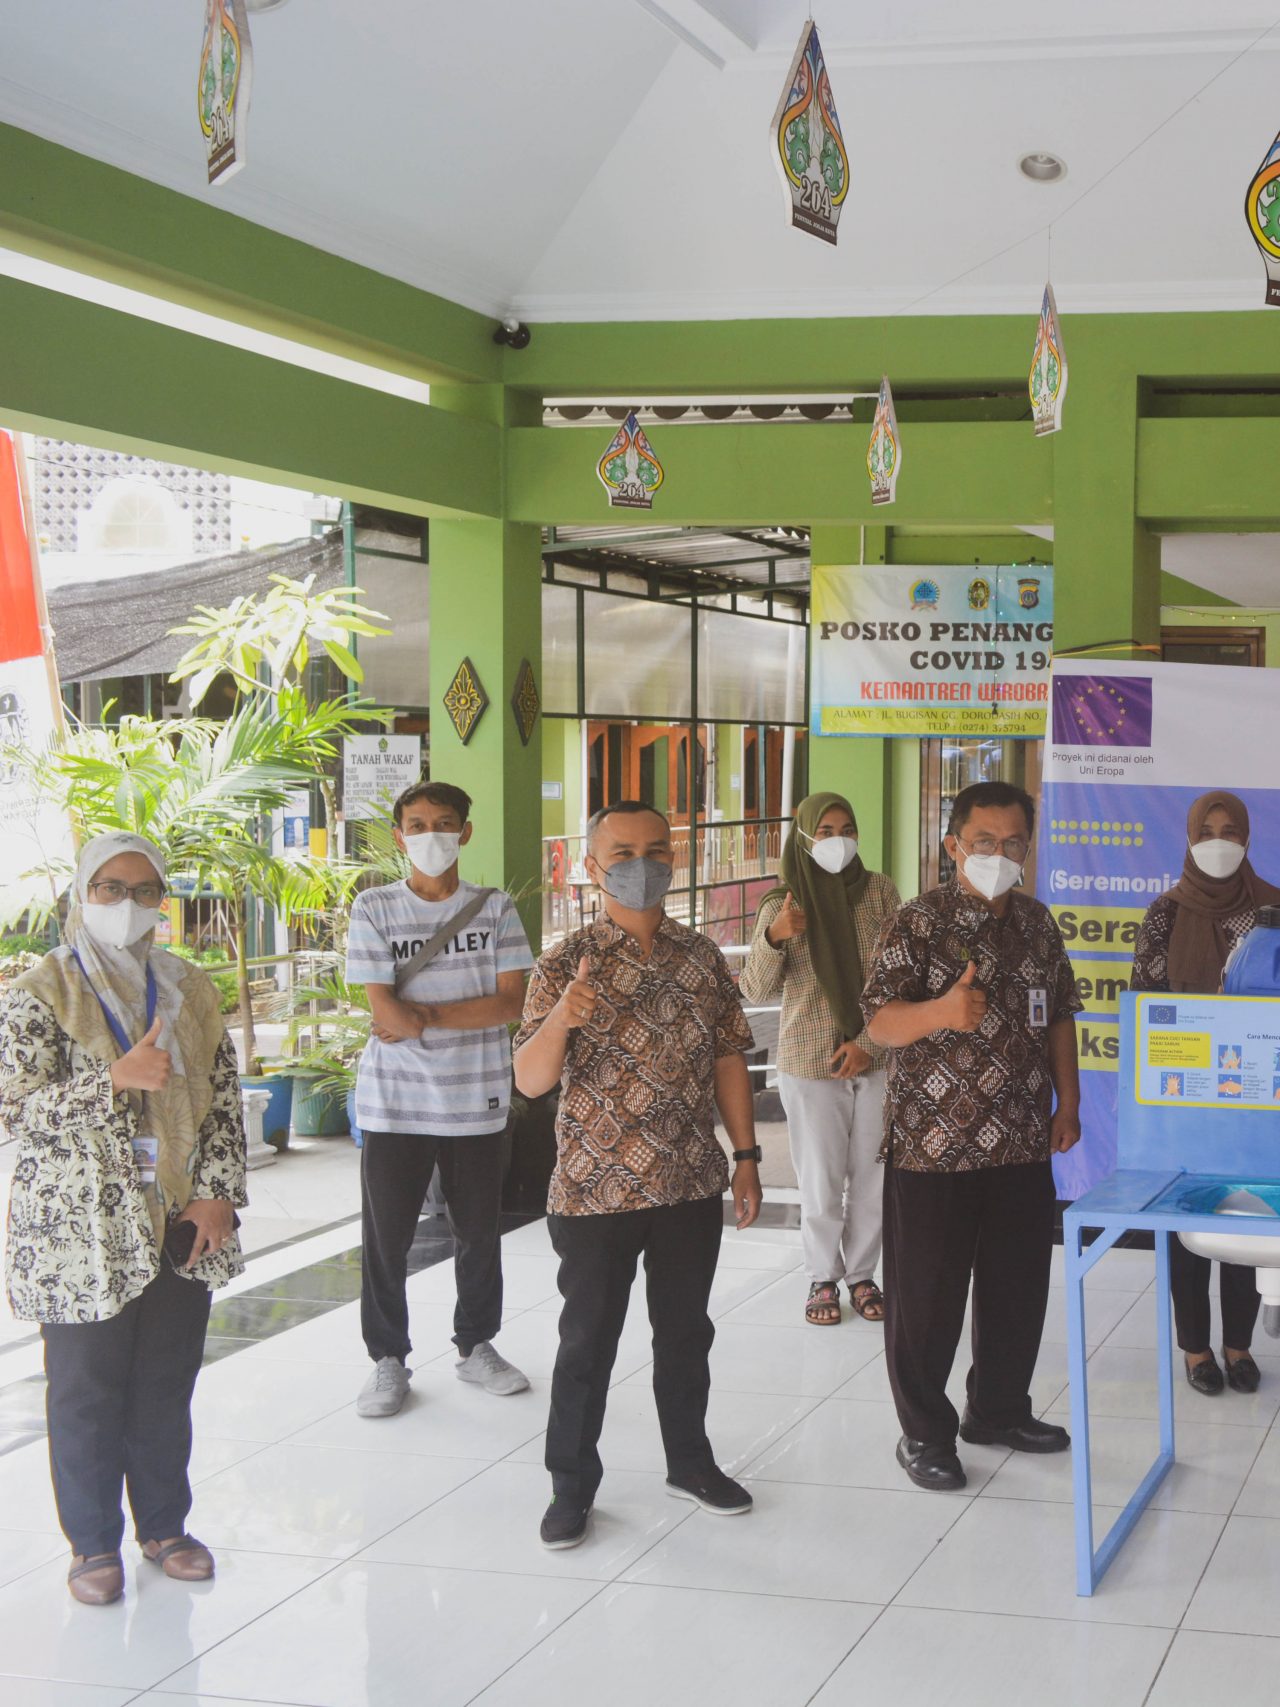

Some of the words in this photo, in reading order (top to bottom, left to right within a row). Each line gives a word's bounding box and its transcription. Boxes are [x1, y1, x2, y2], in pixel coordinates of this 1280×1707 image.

[801, 175, 832, 220] 264
[619, 481, 646, 500] 264
[820, 621, 921, 641] POSKO
[929, 622, 1053, 642] PENANG
[909, 650, 1005, 670] COVID
[860, 681, 972, 701] KEMANTREN
[833, 710, 872, 719] ALAMAT
[896, 711, 938, 719] BUGISAN
[351, 754, 381, 765] TANAH
[383, 754, 414, 765] WAKAF
[1052, 752, 1082, 763] Proyek
[1085, 753, 1096, 762] ini
[1097, 753, 1131, 763] didanai
[1133, 755, 1154, 764] oleh
[1079, 766, 1094, 775] Uni
[1097, 766, 1125, 777] Eropa
